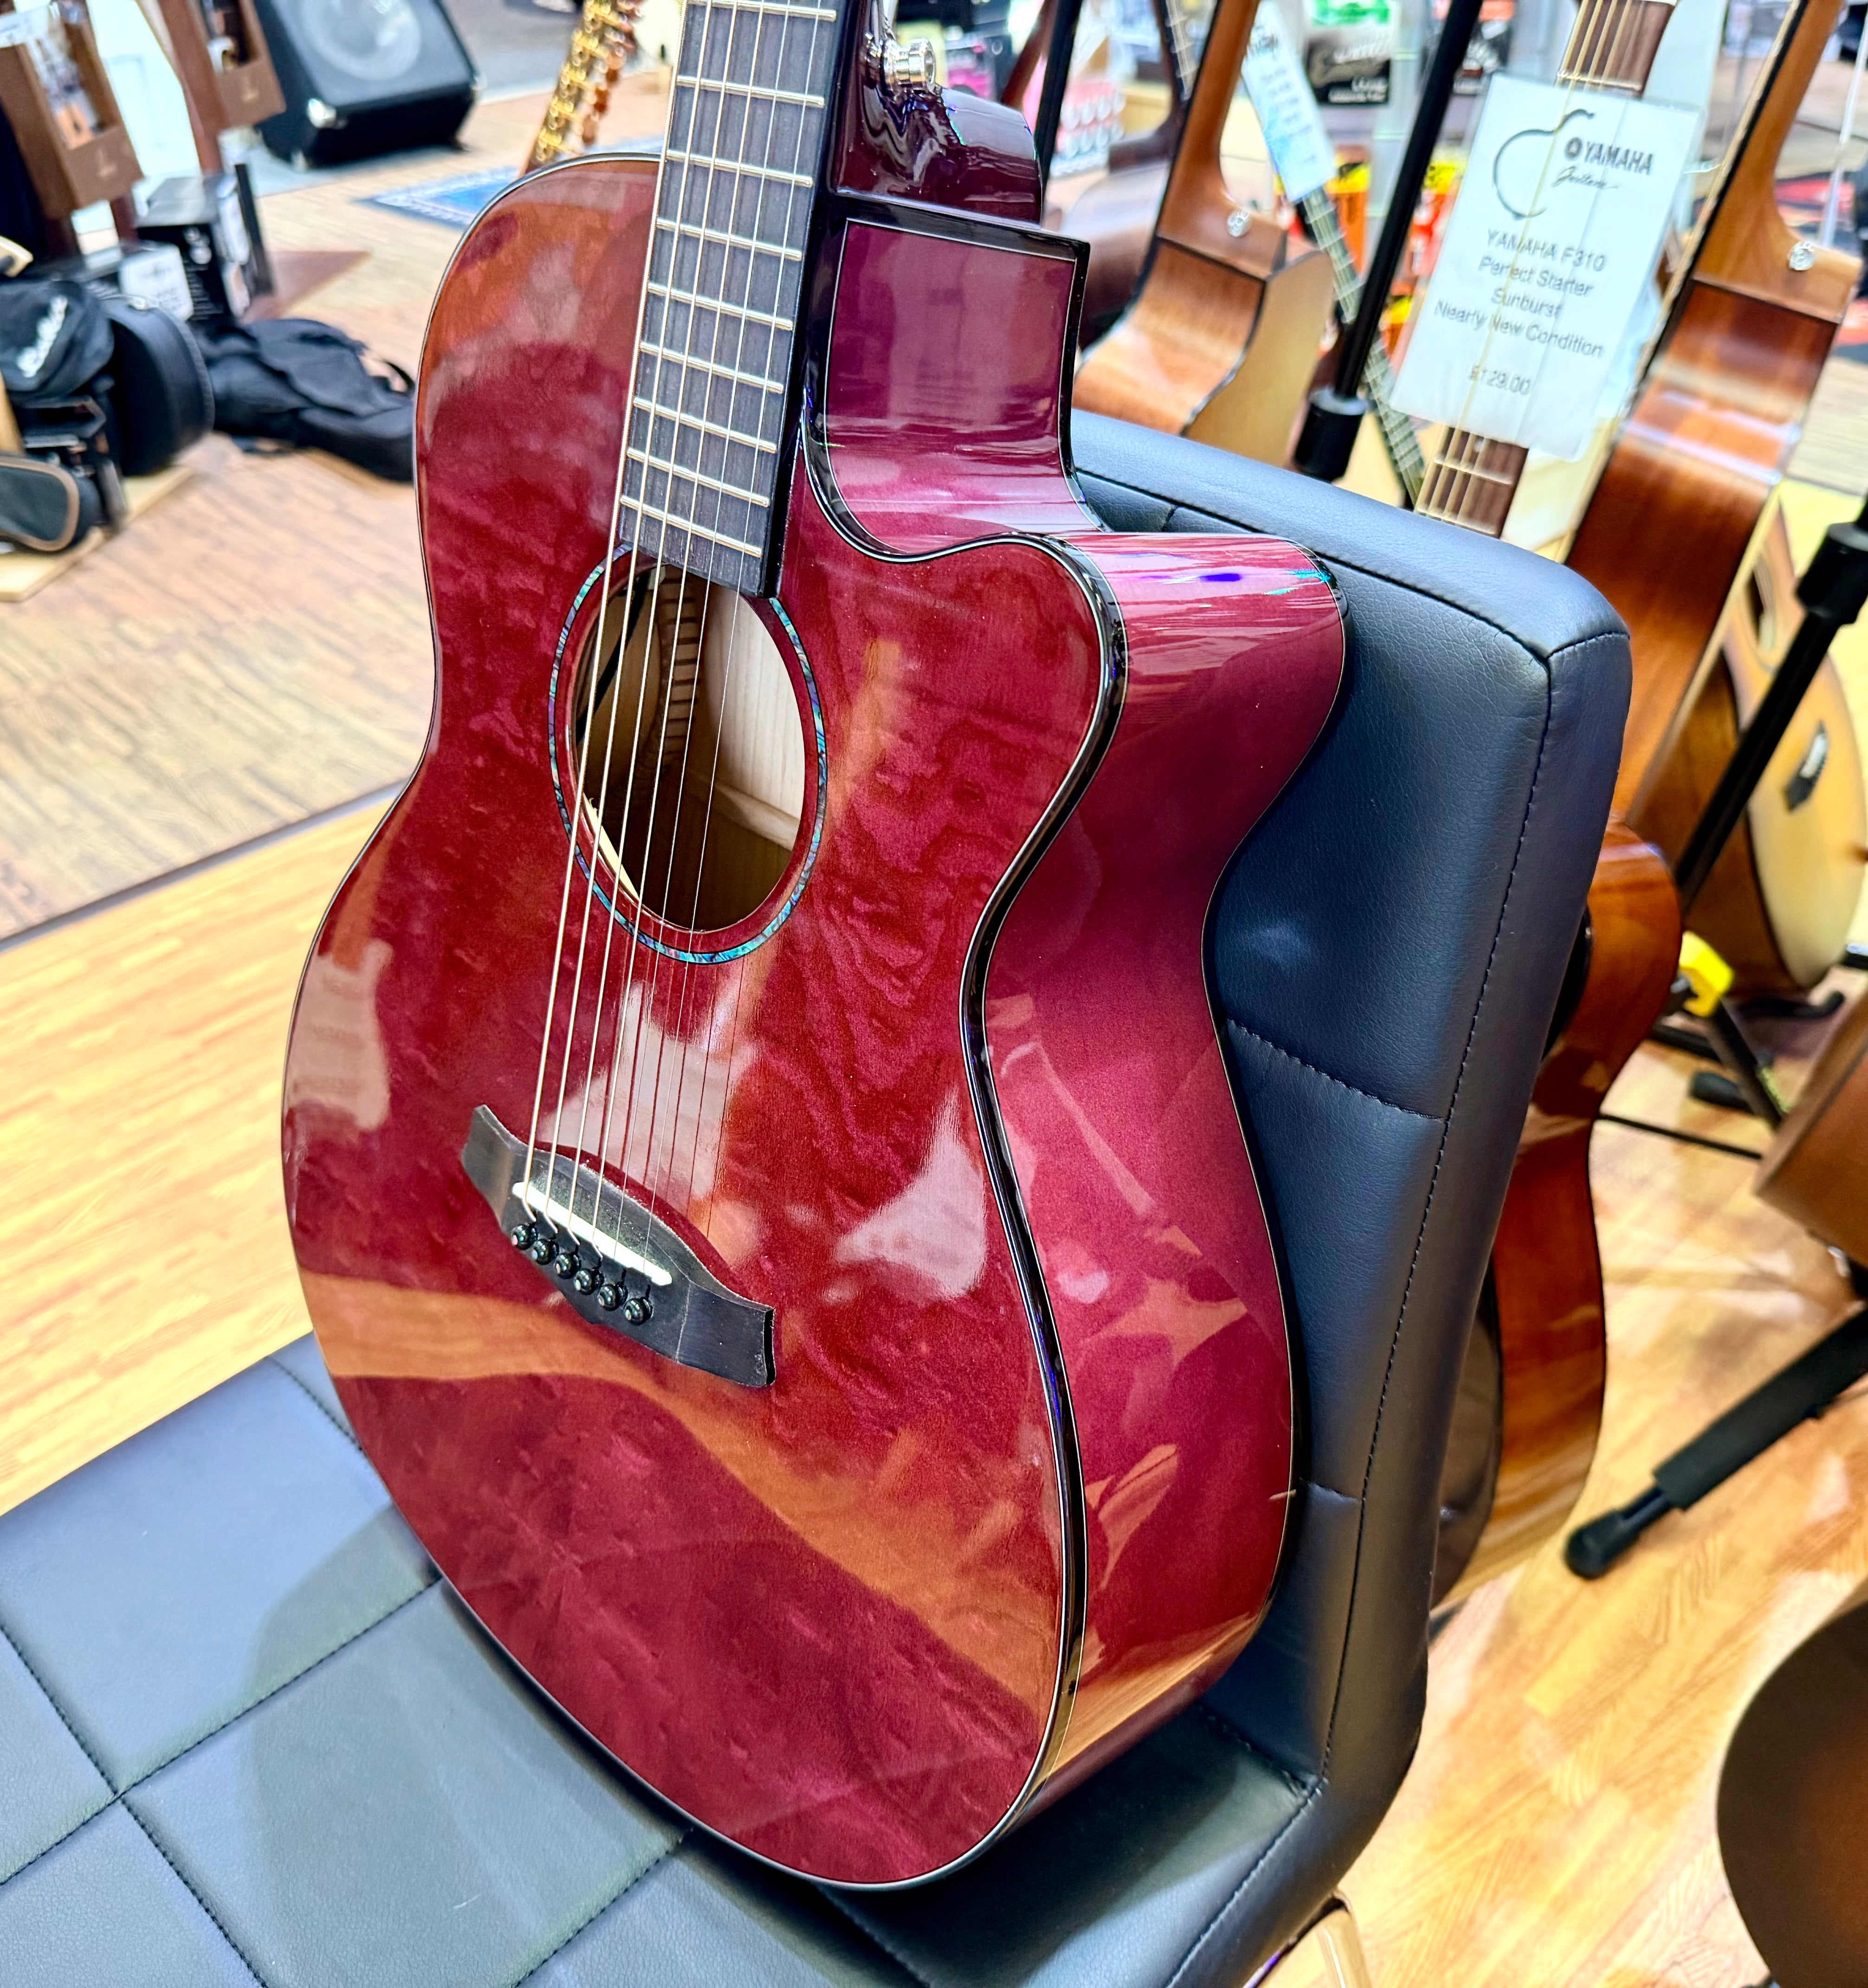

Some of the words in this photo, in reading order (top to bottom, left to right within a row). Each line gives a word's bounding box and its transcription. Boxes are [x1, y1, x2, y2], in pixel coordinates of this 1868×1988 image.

[1585, 141, 1654, 175] YAMAHA
[1560, 246, 1605, 272] F310
[1536, 269, 1594, 297] Starter
[1491, 287, 1562, 318] Sunburst
[1434, 300, 1488, 330] Nearly
[1488, 314, 1524, 336] New
[1525, 323, 1605, 359] Condition
